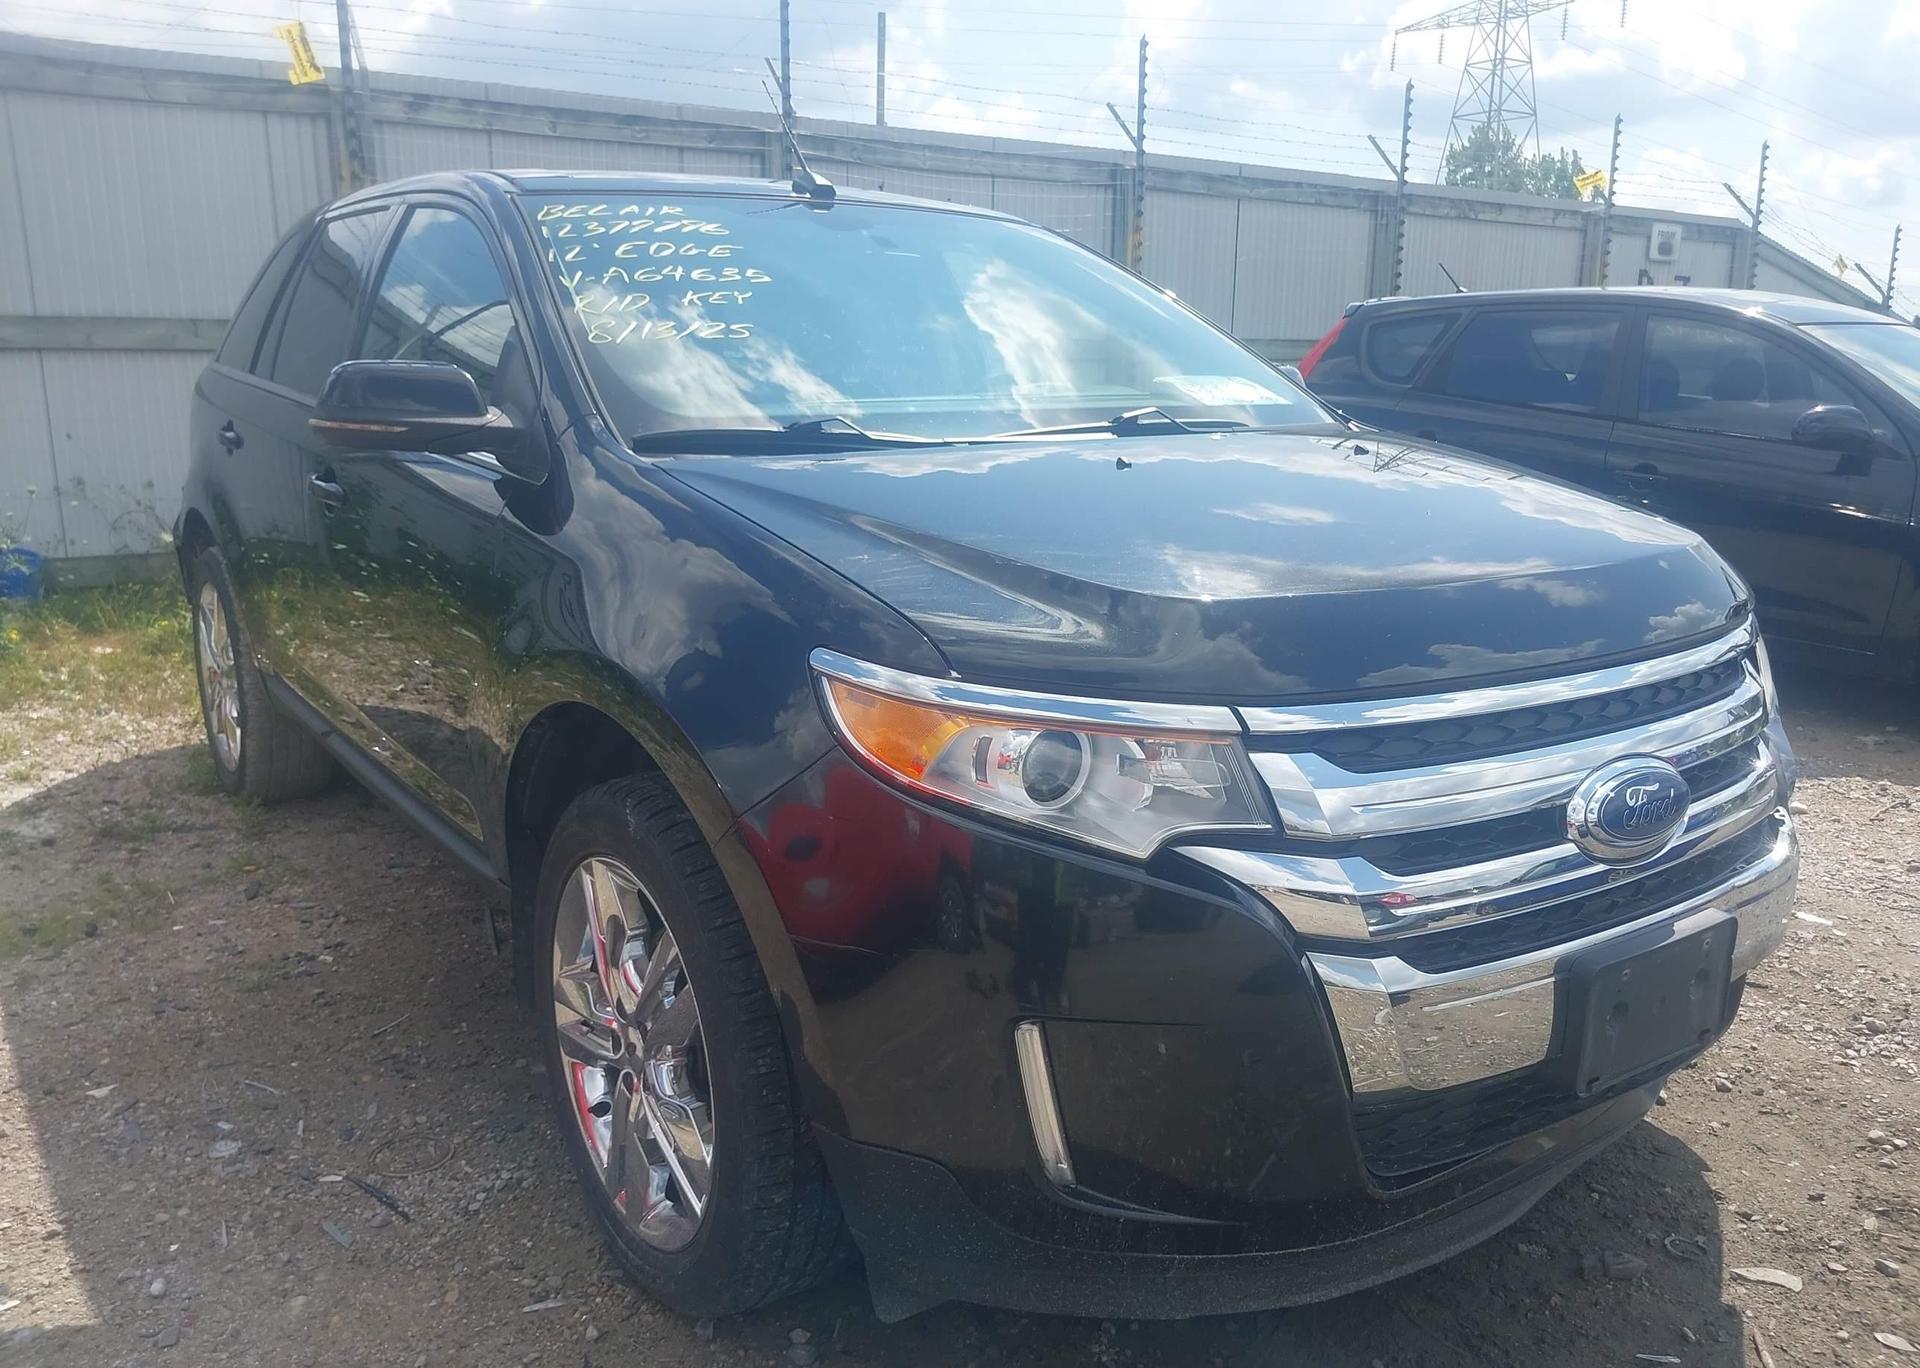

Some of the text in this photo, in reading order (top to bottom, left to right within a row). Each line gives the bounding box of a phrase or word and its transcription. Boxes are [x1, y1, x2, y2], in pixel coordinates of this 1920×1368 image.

[614, 241, 744, 259] EDGE
[681, 290, 752, 306] KEY
[1622, 783, 1677, 830] Ford
